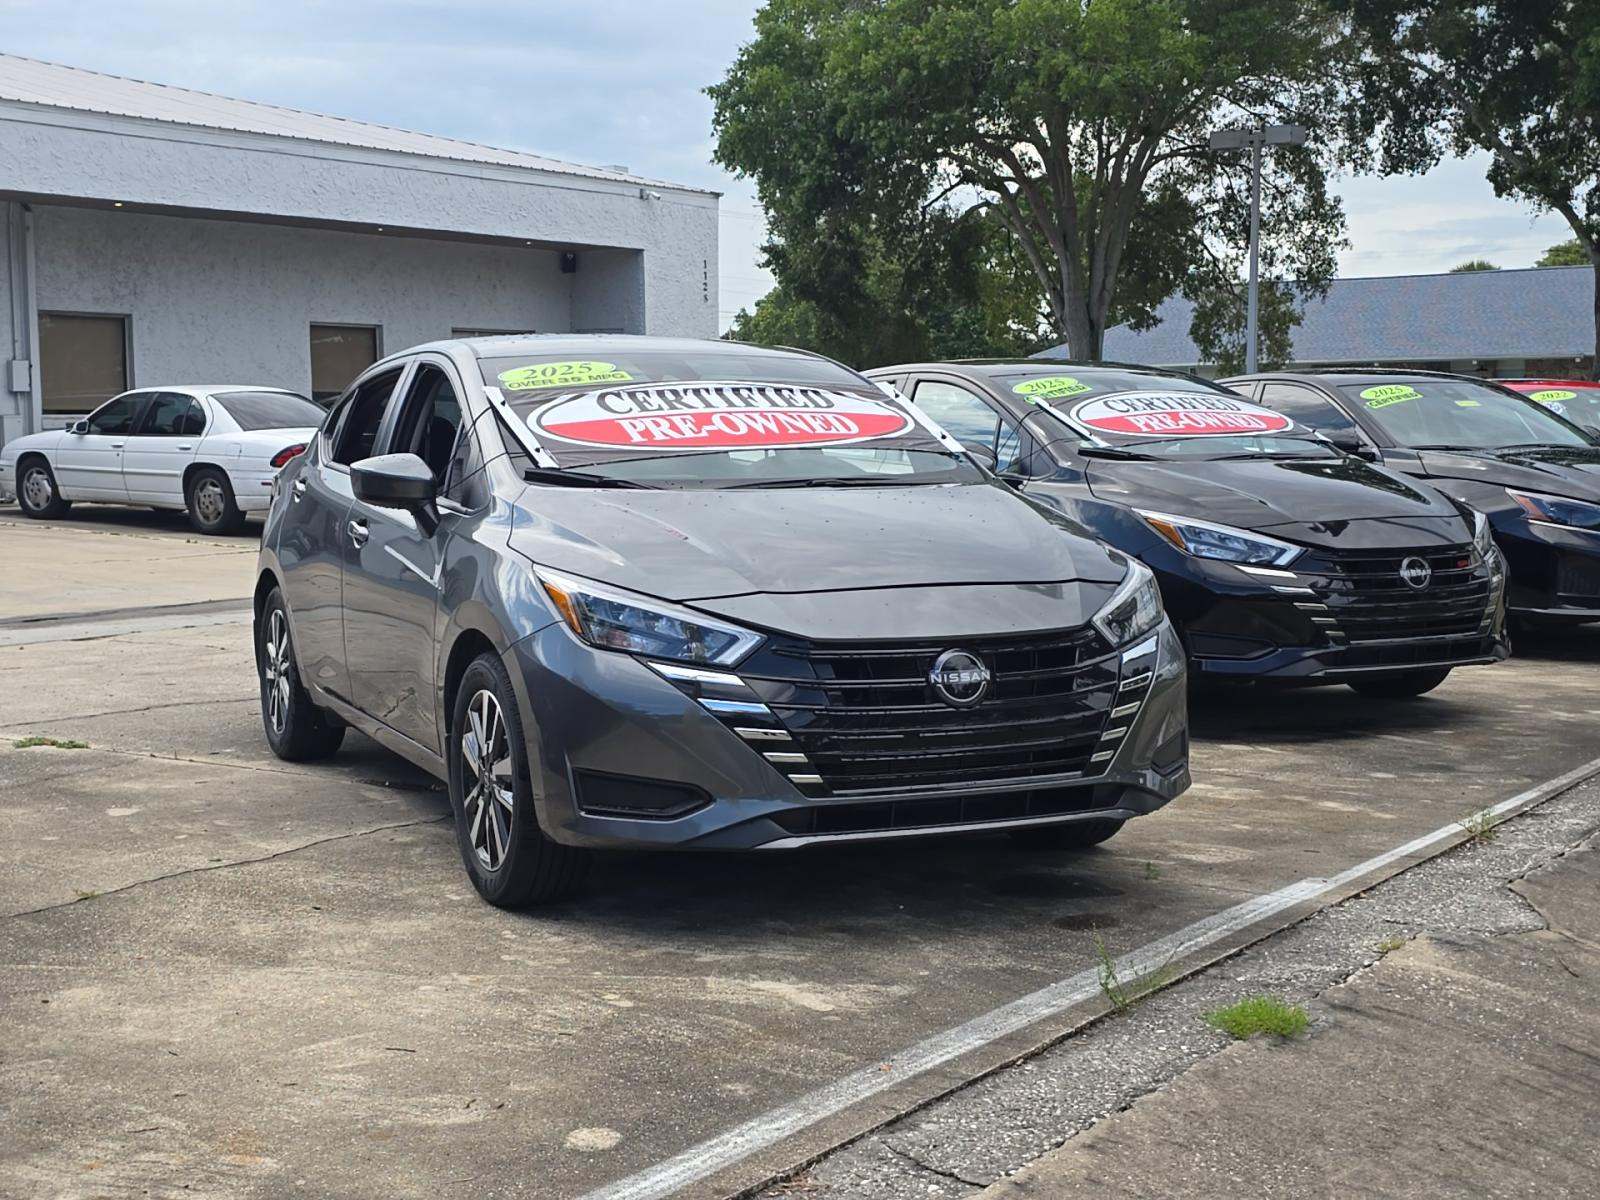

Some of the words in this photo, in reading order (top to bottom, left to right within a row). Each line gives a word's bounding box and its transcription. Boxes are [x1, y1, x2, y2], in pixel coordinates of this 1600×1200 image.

[523, 362, 592, 380] 2025
[508, 378, 556, 388] OVER
[588, 372, 626, 381] MPG
[1025, 379, 1065, 392] 2025
[1369, 392, 1418, 406] CERTIFIED
[1370, 386, 1404, 397] 2025
[596, 386, 834, 415] CERTIFIED
[1102, 396, 1242, 413] CERTIFIED
[615, 411, 860, 443] PRE-OWNED
[1124, 411, 1268, 432] PRE-OWNED
[930, 671, 990, 684] NISSAN
